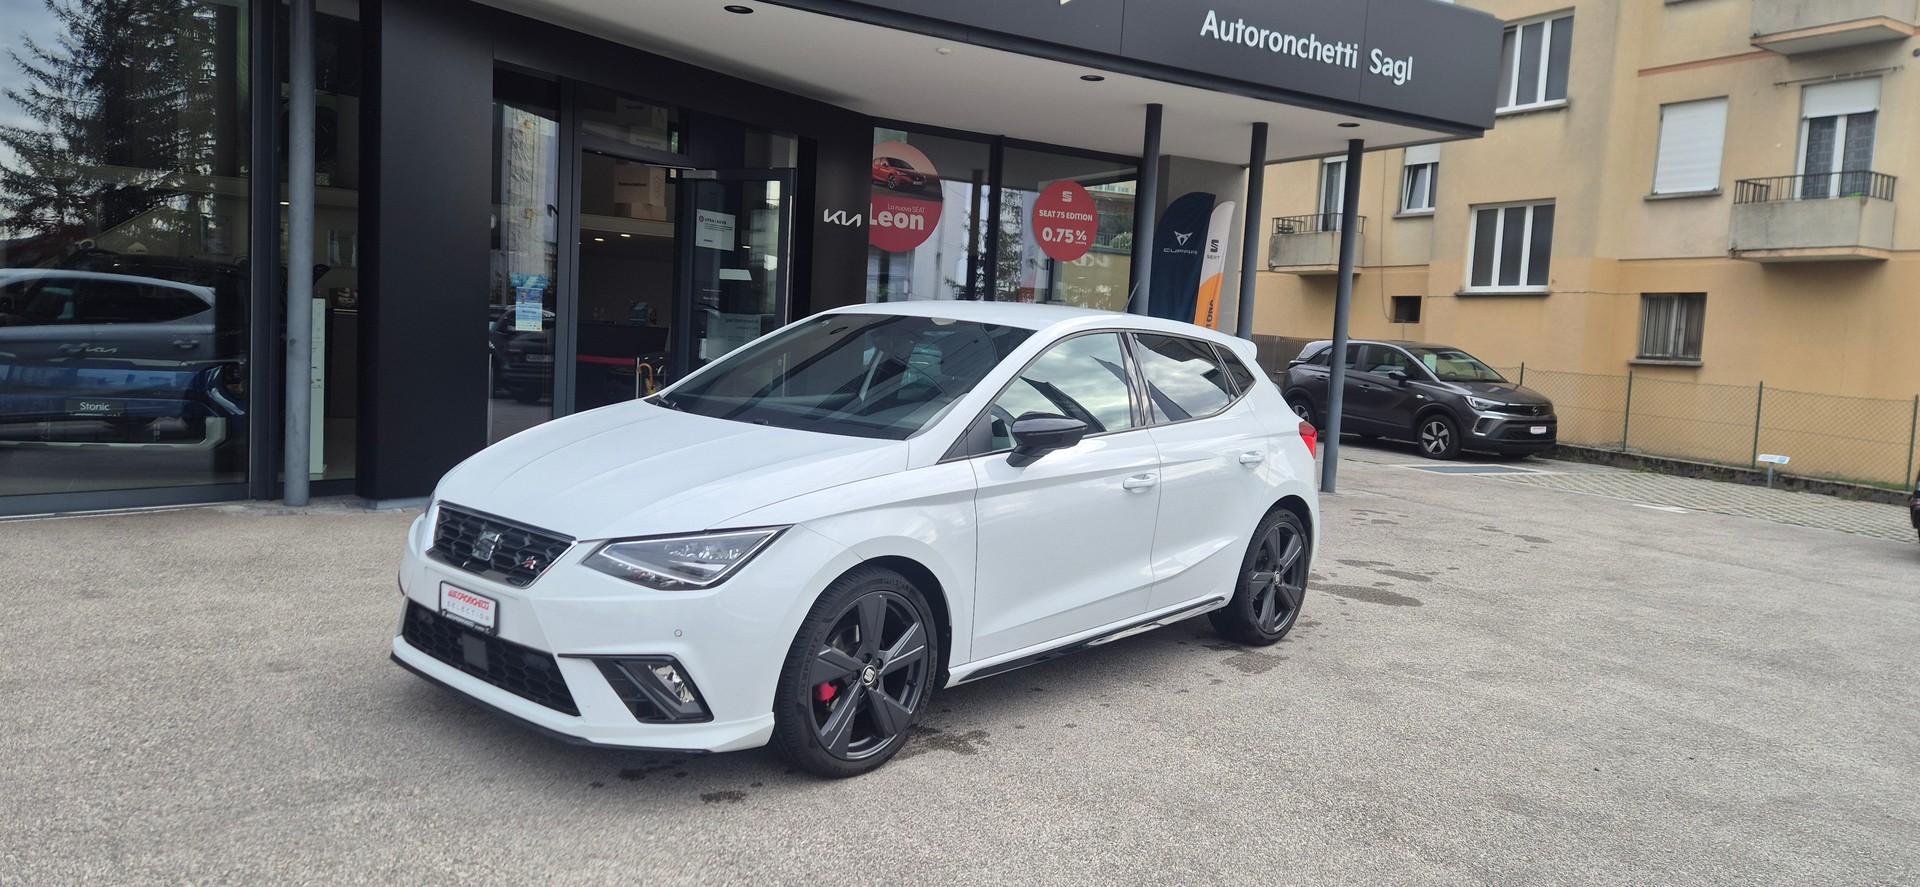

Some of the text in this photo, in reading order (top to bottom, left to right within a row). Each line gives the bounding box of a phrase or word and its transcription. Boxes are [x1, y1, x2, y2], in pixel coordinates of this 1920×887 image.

[1200, 9, 1413, 86] Autoronchetti Sagl
[869, 203, 924, 230] Leon
[1039, 209, 1093, 221] SEAT 75 EDITION
[1042, 227, 1074, 243] 0.75
[1163, 247, 1198, 255] CUPRA
[80, 401, 111, 411] Stonic
